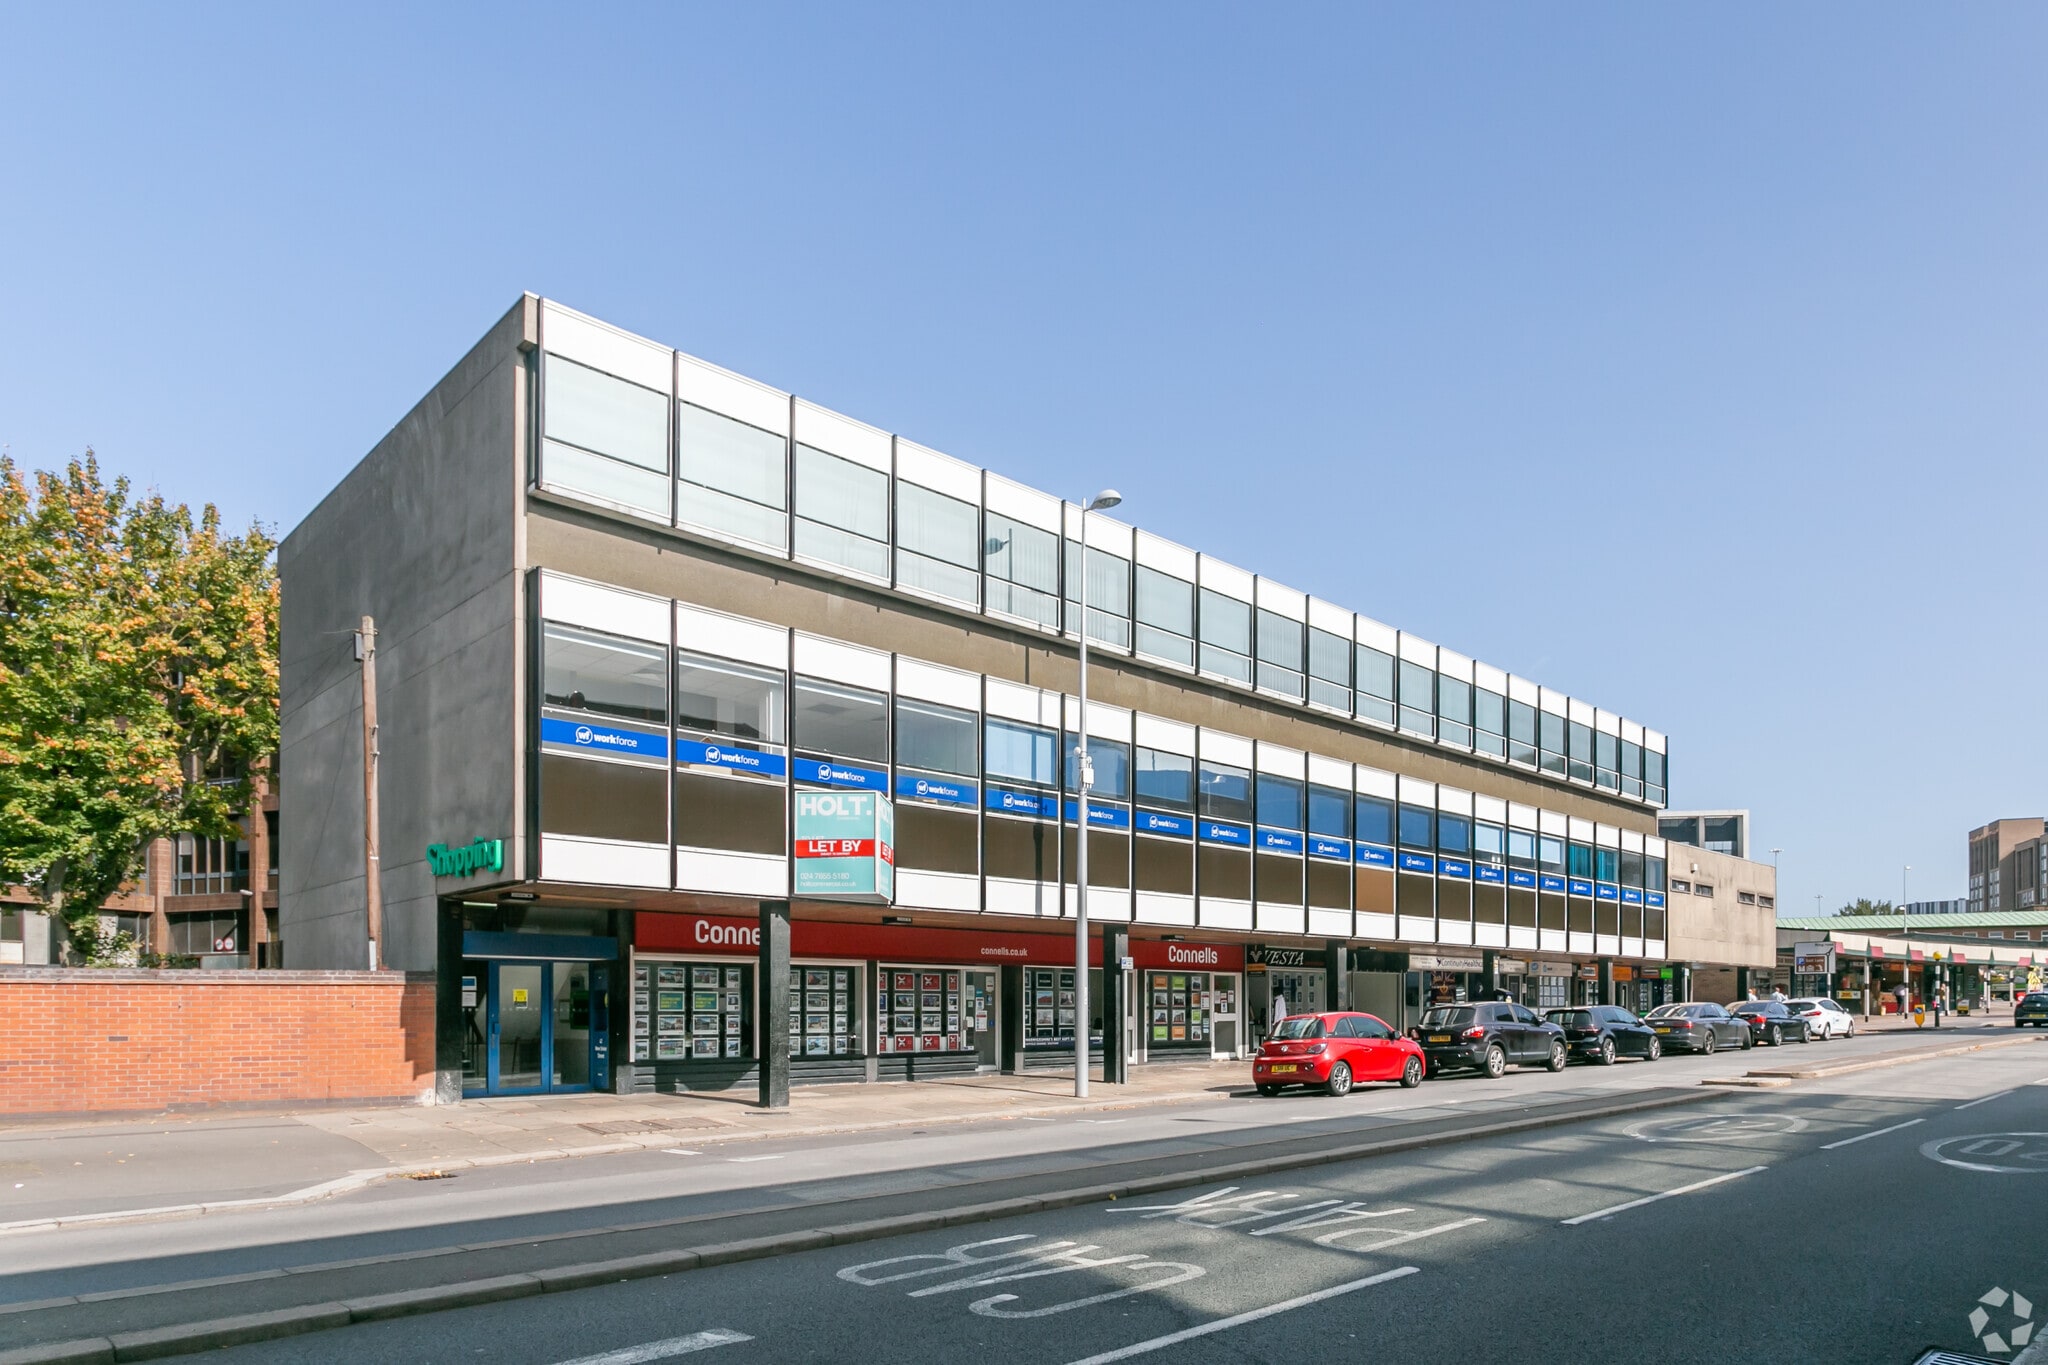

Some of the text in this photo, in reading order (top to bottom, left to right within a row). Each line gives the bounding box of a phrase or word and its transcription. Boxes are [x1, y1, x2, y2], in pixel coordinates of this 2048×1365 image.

[593, 734, 638, 748] workforce
[721, 753, 760, 766] workforce
[832, 771, 866, 783] workforce
[928, 786, 959, 797] workforce
[808, 840, 862, 852] LET BY
[426, 836, 503, 878] Shopping
[695, 919, 760, 946] Conne
[980, 946, 1028, 957] connells.co.uk
[1168, 945, 1218, 964] Connells
[1265, 950, 1304, 965] VESTA
[1105, 1186, 1487, 1252] PARK
[836, 1234, 1207, 1318] CAR
